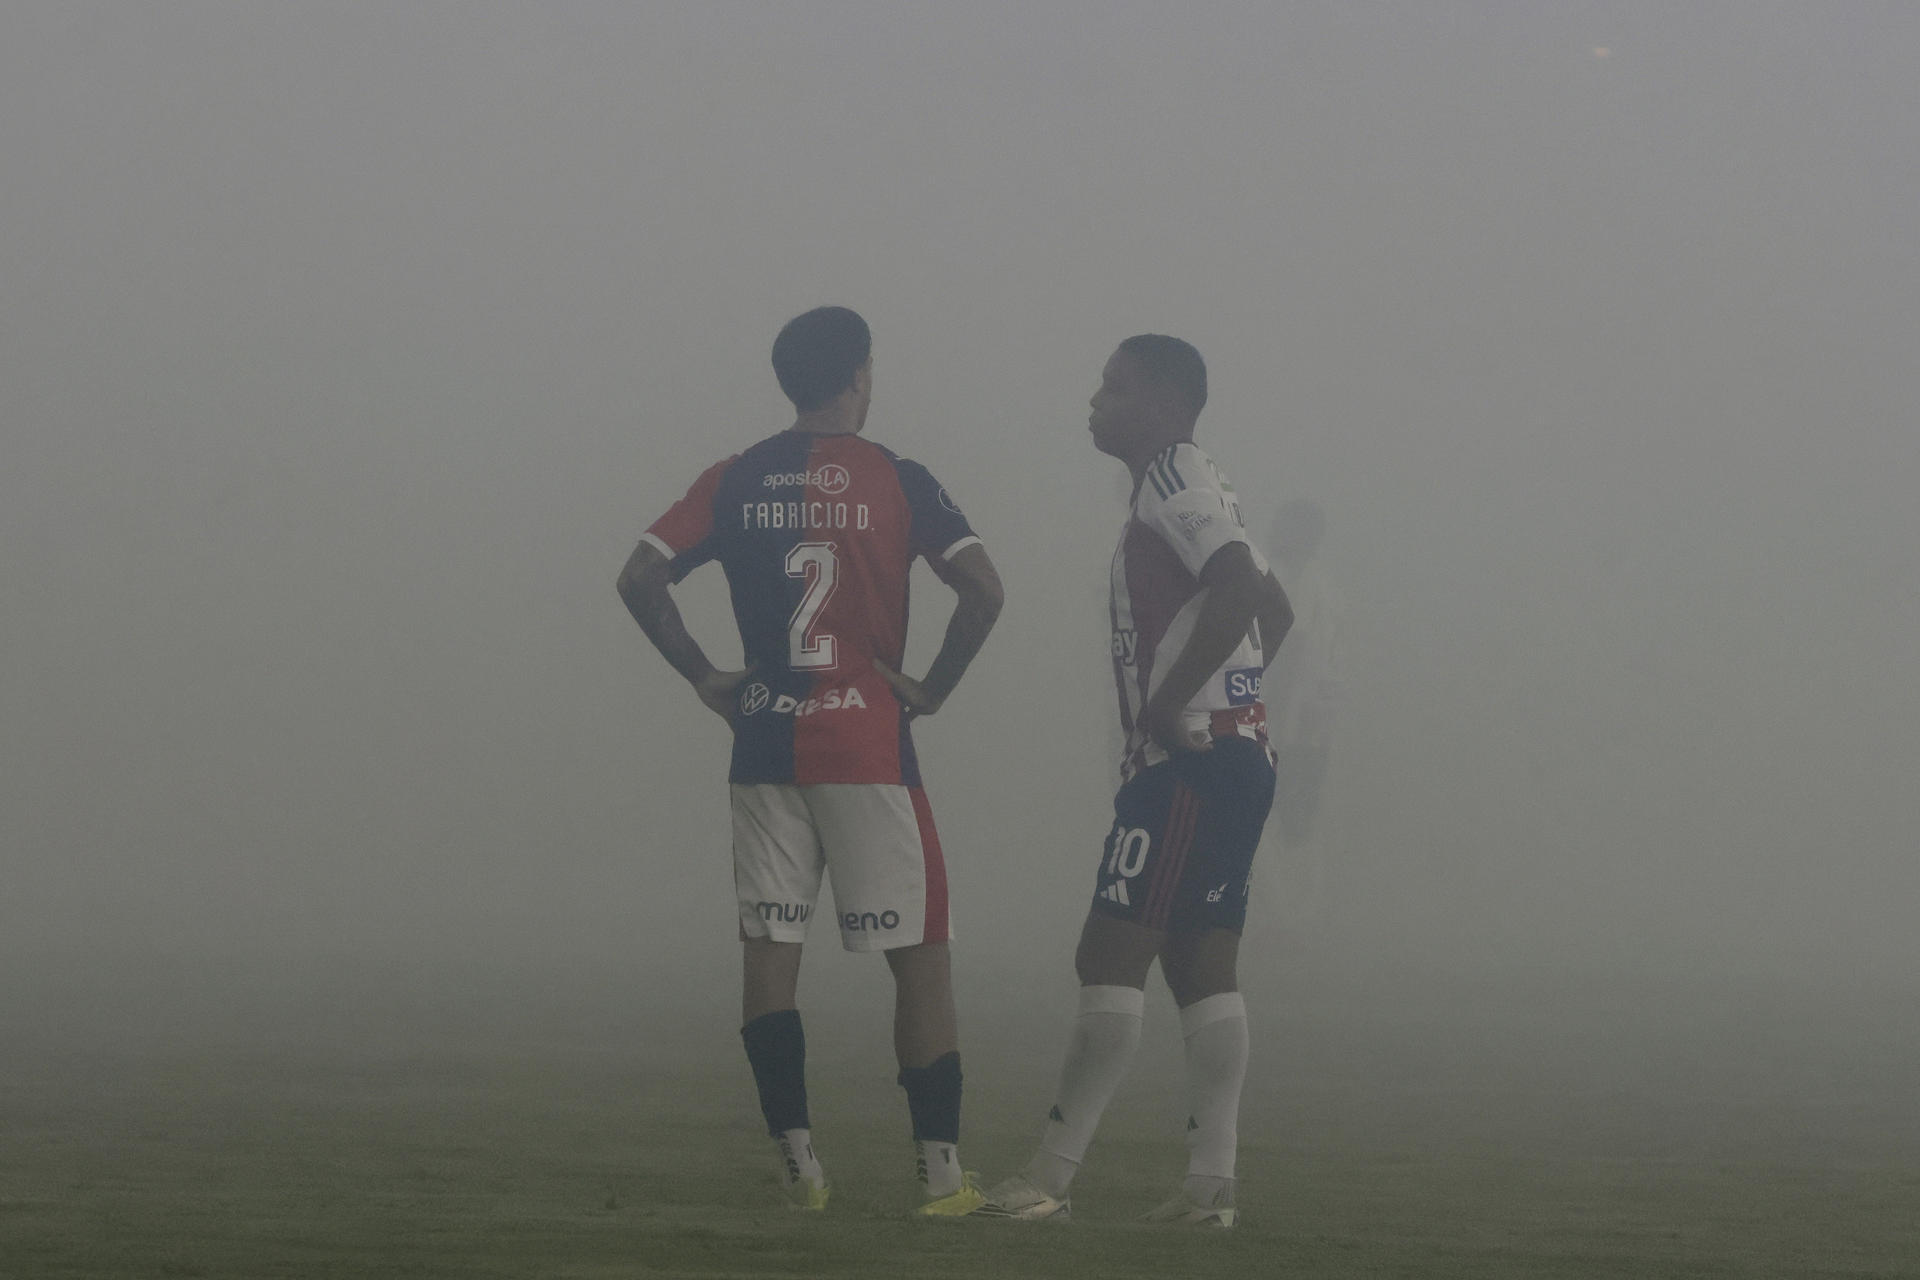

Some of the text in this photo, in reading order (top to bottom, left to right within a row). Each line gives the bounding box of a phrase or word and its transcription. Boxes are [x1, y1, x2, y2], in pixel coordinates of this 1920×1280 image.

[743, 502, 847, 530] FABRICIO
[785, 542, 839, 671] 2
[1108, 826, 1151, 878] 10
